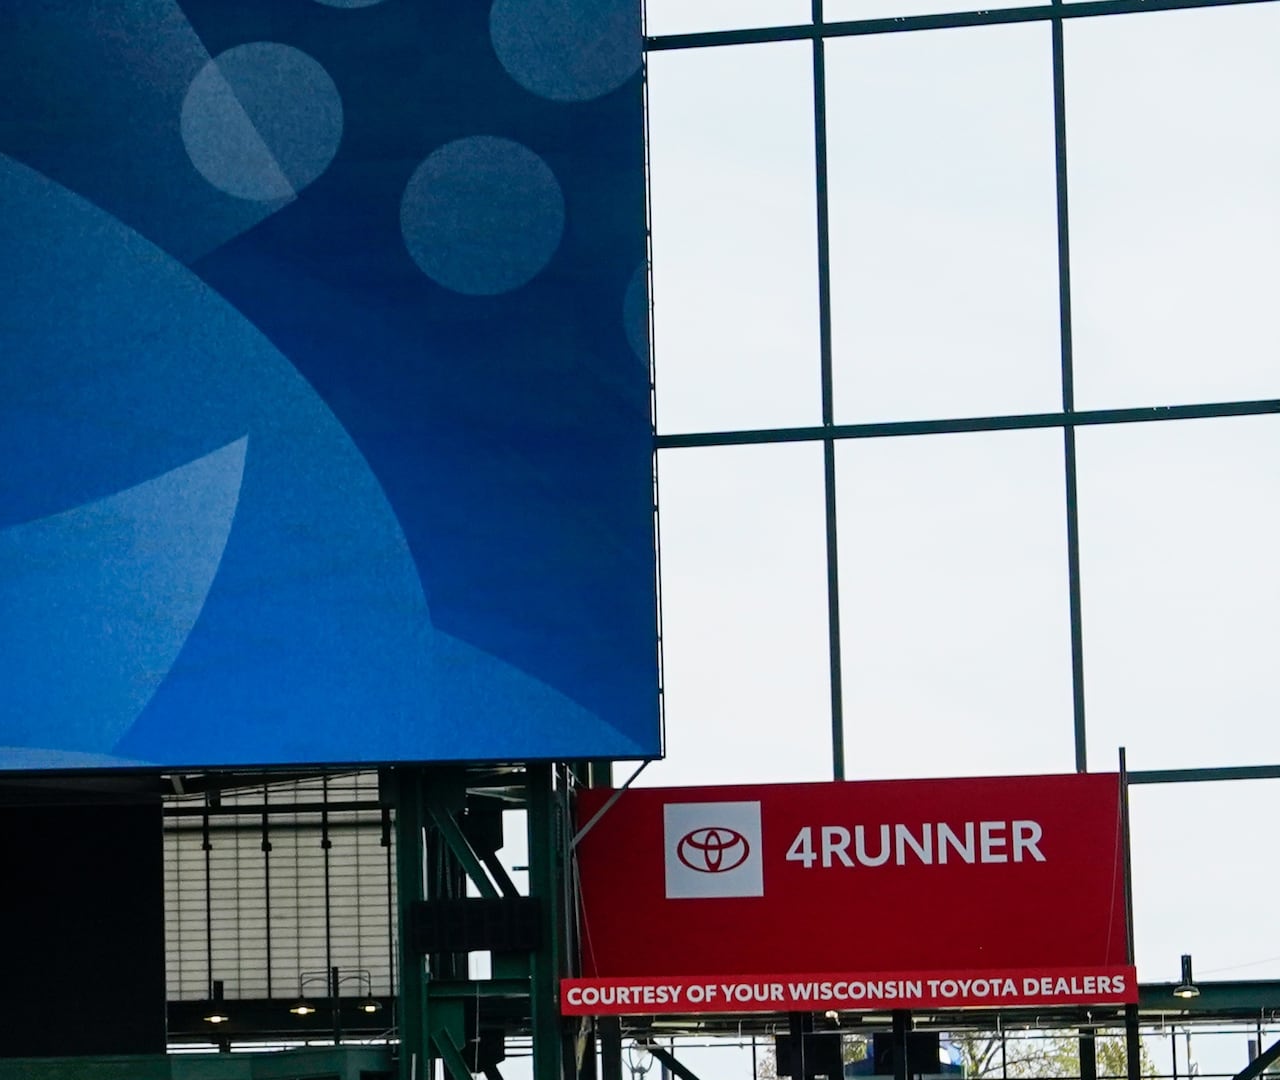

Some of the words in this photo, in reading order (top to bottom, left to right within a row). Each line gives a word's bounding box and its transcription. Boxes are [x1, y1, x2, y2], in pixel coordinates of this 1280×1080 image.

[786, 820, 1047, 868] 4RUNNER
[567, 985, 682, 1005] COURTESY
[686, 984, 719, 1003] OF
[720, 983, 785, 1002] YOUR
[788, 980, 922, 1001] WISCONSIN
[927, 978, 1018, 998] TOYOTA
[1023, 975, 1126, 996] DEALERS
